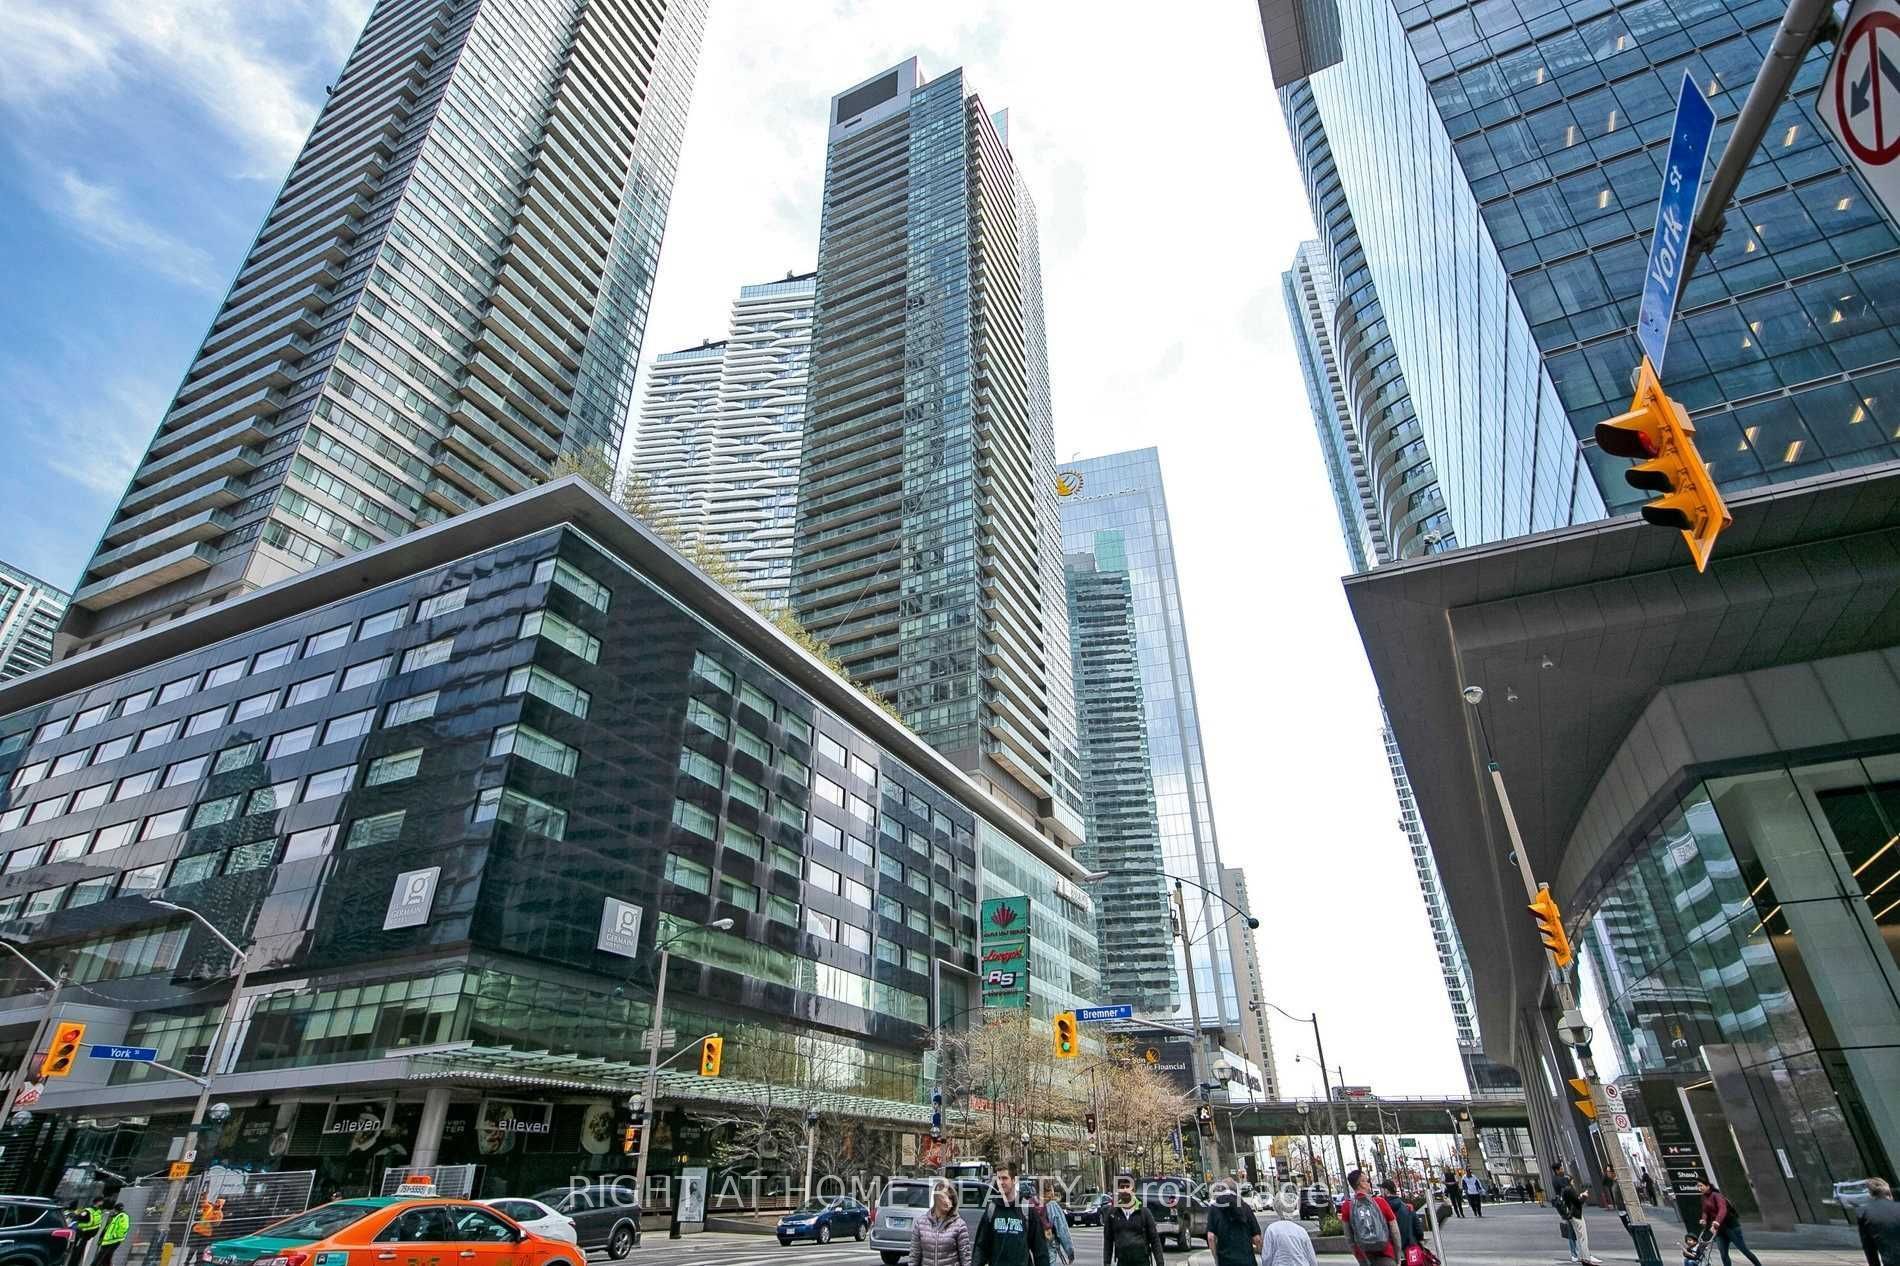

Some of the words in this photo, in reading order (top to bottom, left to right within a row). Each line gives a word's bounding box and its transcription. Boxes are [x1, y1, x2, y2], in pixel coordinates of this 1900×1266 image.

[1652, 204, 1683, 294] York
[1670, 164, 1683, 193] St
[1083, 1009, 1118, 1019] Bremner
[110, 1048, 131, 1058] York
[1154, 1061, 1186, 1070] Financial
